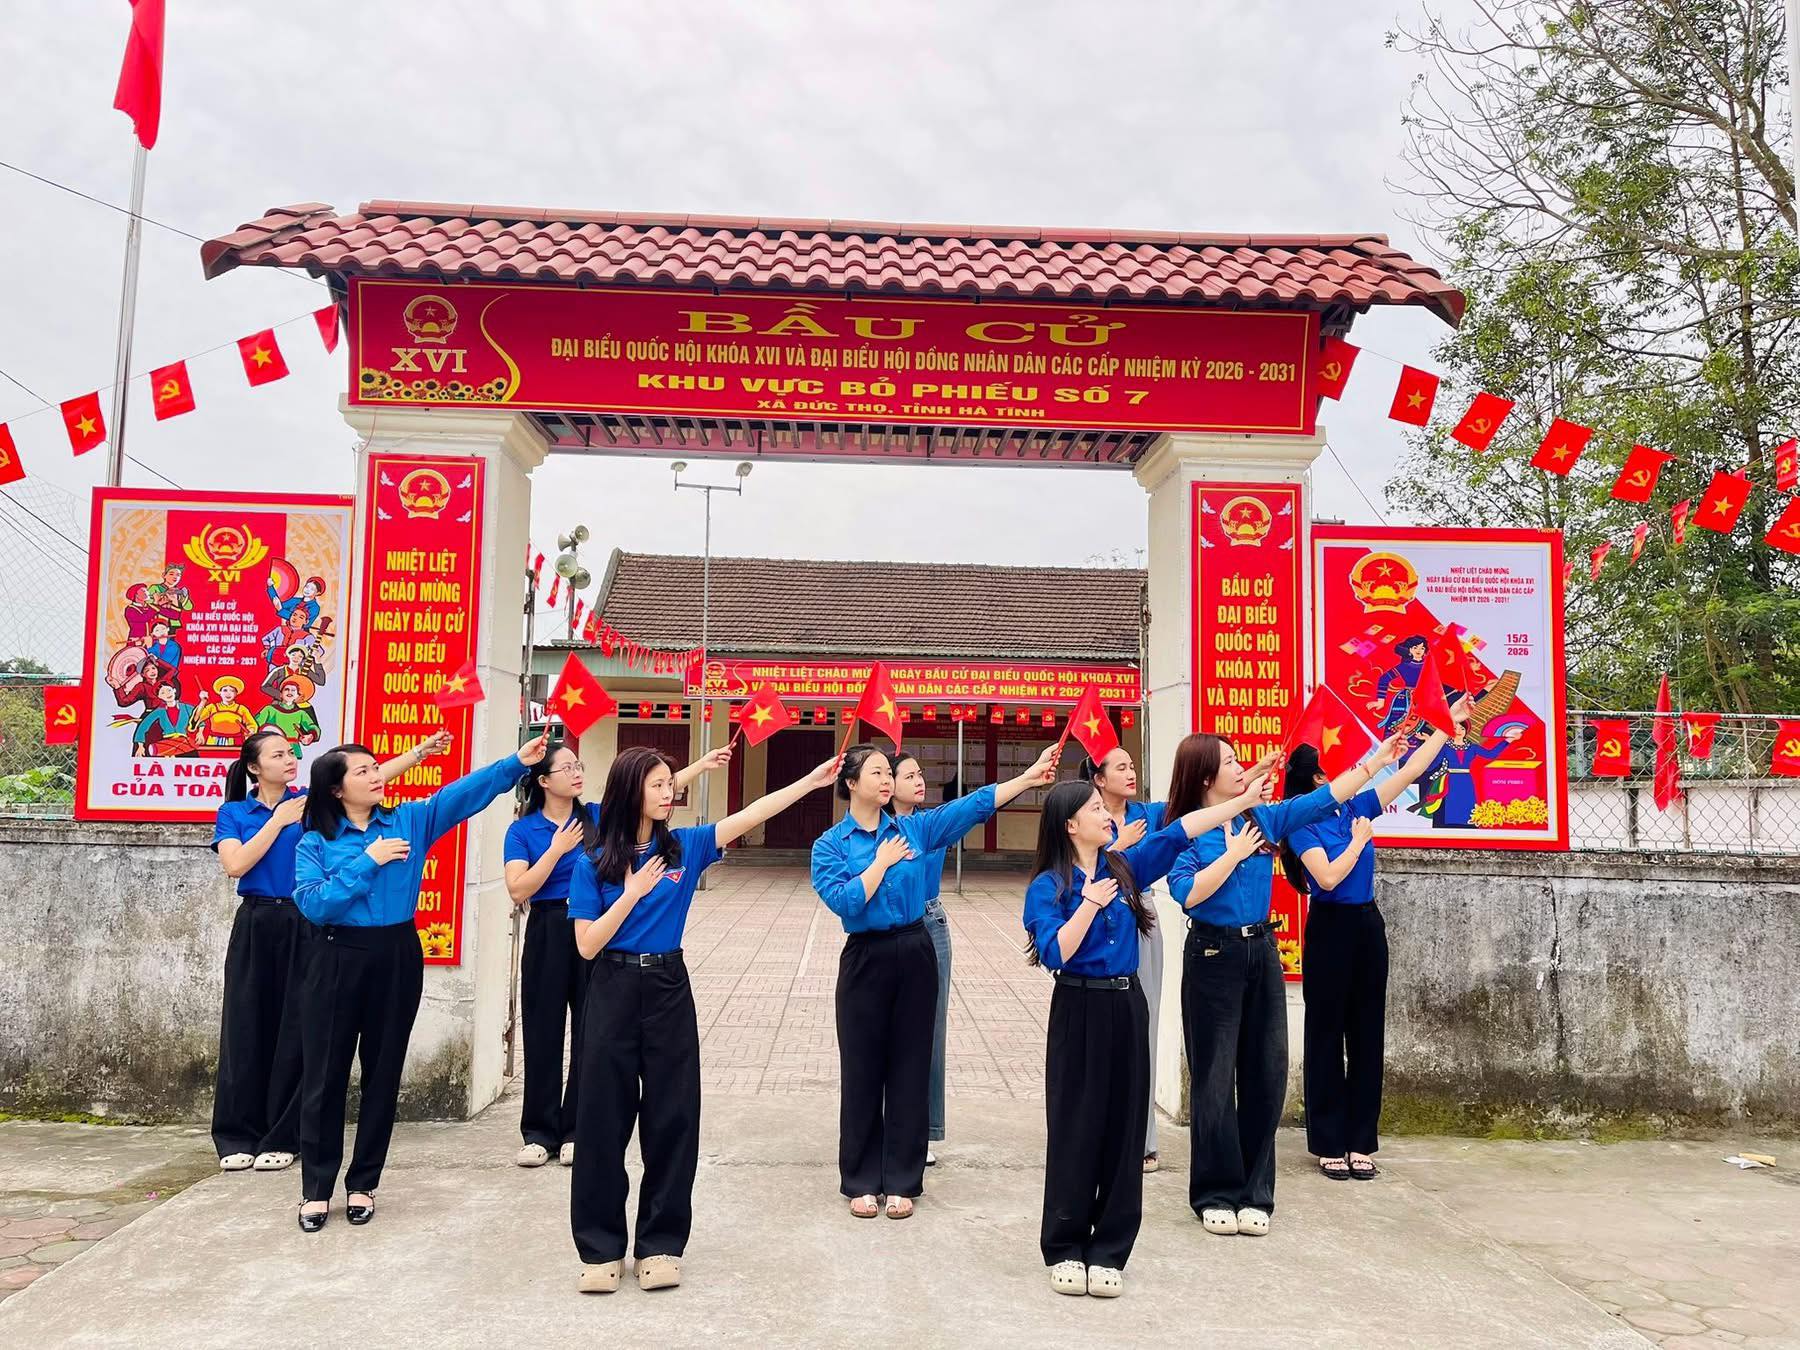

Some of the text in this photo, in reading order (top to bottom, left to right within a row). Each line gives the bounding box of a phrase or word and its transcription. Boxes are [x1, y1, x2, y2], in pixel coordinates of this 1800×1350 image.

[678, 302, 1127, 346] BẦU CỬ
[390, 347, 468, 373] XVI
[551, 337, 579, 362] ĐẠI
[584, 332, 621, 360] BIỂU
[626, 335, 669, 362] QUỐC
[674, 339, 702, 366] HỘI
[706, 341, 750, 364] KHÓA
[754, 346, 780, 366] XVI
[785, 343, 806, 367] VÀ
[810, 347, 837, 371] ĐẠI
[842, 342, 879, 369] BIỂU
[884, 346, 910, 373] HỘI
[915, 345, 959, 372] ĐỒNG
[964, 349, 1009, 373] NHÂN
[1013, 351, 1047, 375] DÂN
[1051, 352, 1083, 375] CÁC
[1087, 351, 1119, 377] CẤP
[1124, 355, 1176, 382] NHIỆM
[1181, 356, 1201, 379] KỲ
[1205, 361, 1244, 380] 2026
[1258, 362, 1296, 382] 2031
[638, 373, 1149, 405] KHU VỰC BỎ PHIẾU SỐ 7
[756, 399, 786, 409] XÃ
[794, 399, 838, 411] ĐỨC
[901, 402, 951, 414] TỈNH
[959, 405, 988, 416] HÀ
[386, 547, 457, 577] NHIỆT LIỆT
[207, 569, 241, 583] XVI
[1222, 572, 1274, 597] BẦU CỬ
[380, 577, 461, 603] CHÀO MỪNG
[374, 605, 465, 633] NGÀY BẦU CỬ
[1217, 599, 1277, 628] ĐẠI BIỂU
[206, 623, 217, 632] XVI
[1506, 634, 1528, 643] 15/3
[387, 635, 446, 667] ĐẠI BIỂU
[1215, 626, 1280, 656] QUỐC HỘI
[1507, 647, 1529, 656] 2026
[383, 665, 420, 695] QUỐC
[752, 666, 788, 679] NHIỆT
[789, 666, 815, 680] LIỆT
[817, 667, 848, 678] CHÀO
[890, 668, 921, 679] NGÀY
[925, 666, 948, 680] BẦU
[952, 666, 969, 680] CỬ
[970, 669, 990, 682] ĐẠI
[993, 667, 1020, 681] BIỂU
[1023, 668, 1055, 682] QUỐC
[1058, 671, 1078, 684] HỘI
[1116, 673, 1134, 684] XVI
[1215, 656, 1280, 680] KHÓA XVI
[793, 679, 820, 692] BIỂU
[823, 681, 843, 695] HỘI
[892, 681, 914, 694] HÂN
[918, 683, 943, 694] DÂN
[945, 682, 971, 695] CÁC
[973, 681, 996, 695] CẤP
[1000, 684, 1037, 697] NHIỆM
[1041, 685, 1056, 697] KỲ
[1099, 688, 1126, 698] 2031
[1206, 681, 1289, 711] VÀ ĐẠI BIỂU
[382, 699, 418, 724] KHÓA
[1215, 710, 1281, 737] HỘI ĐỒNG
[372, 729, 389, 755] VÀ
[133, 762, 228, 777] LÀ NGÀ
[112, 778, 223, 797] CỦA TOÀ
[416, 890, 441, 912] 031
